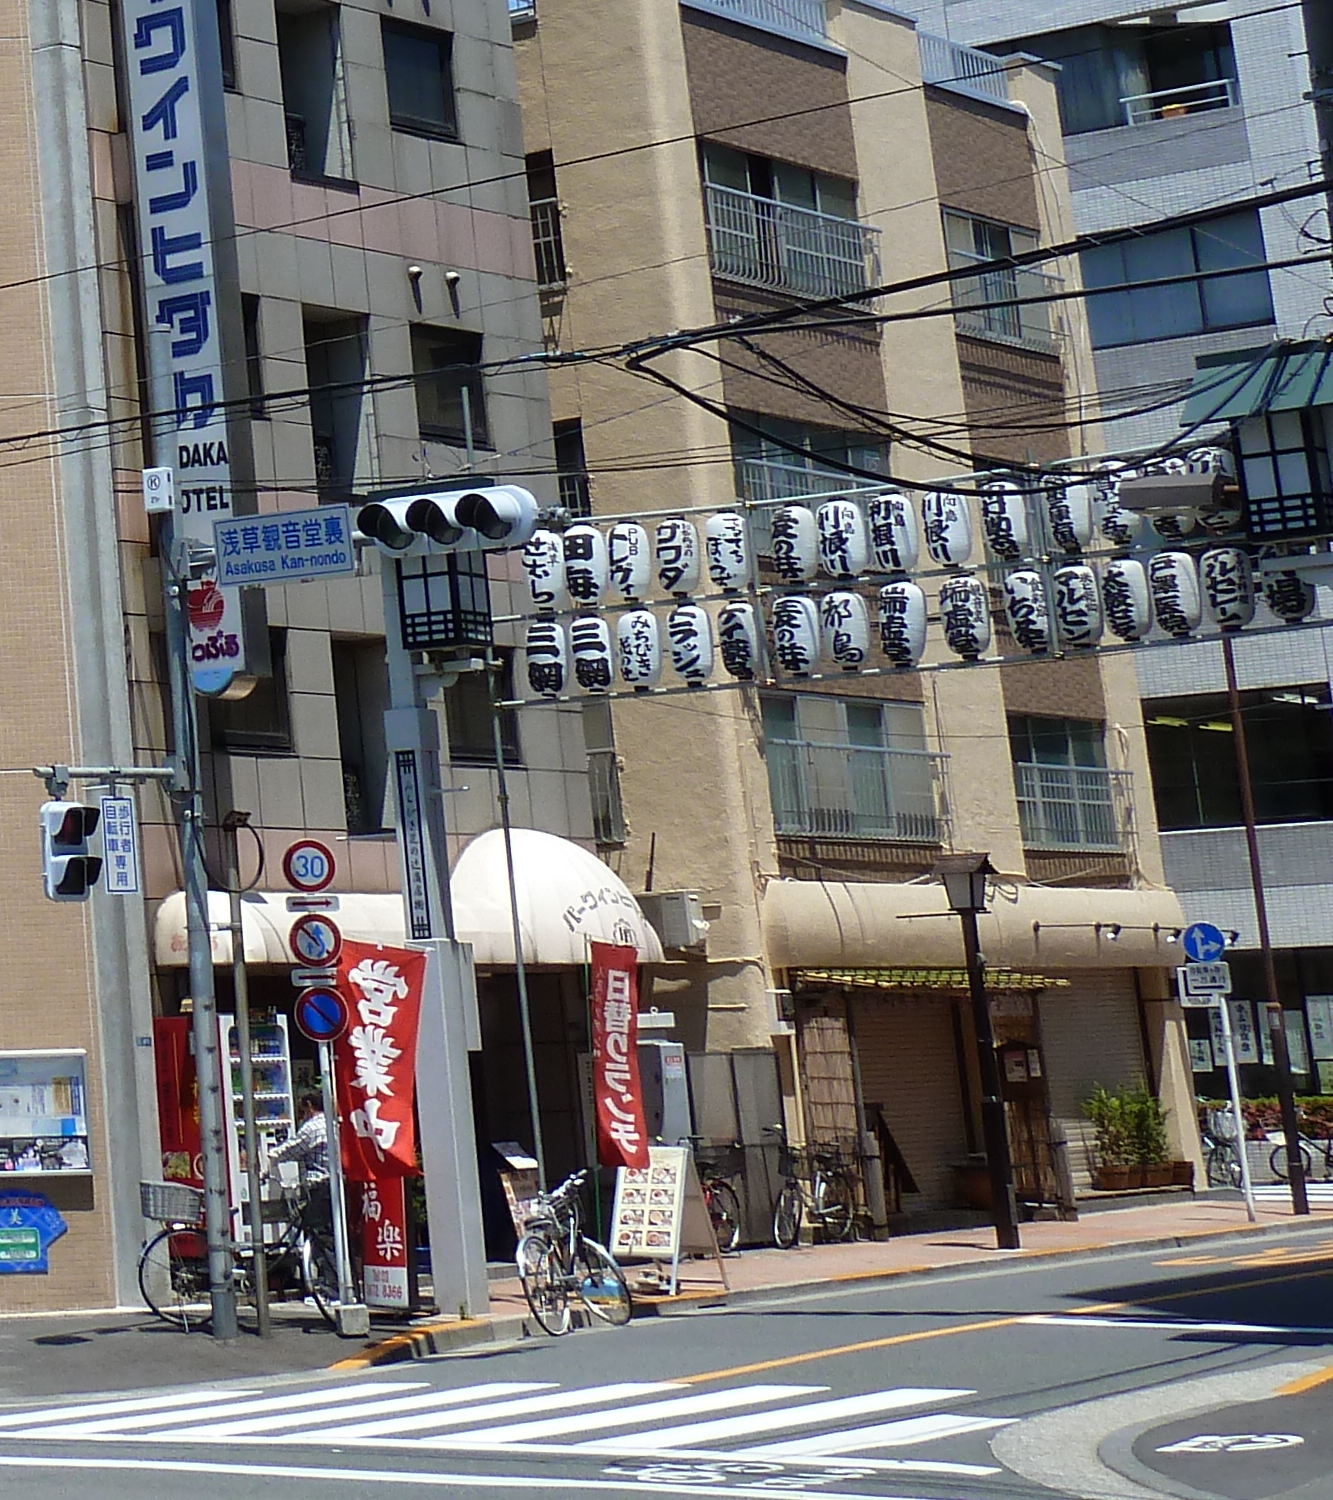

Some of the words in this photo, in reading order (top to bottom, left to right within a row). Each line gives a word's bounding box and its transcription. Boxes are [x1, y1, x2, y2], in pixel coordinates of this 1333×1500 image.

[220, 516, 345, 557] 浅草観音堂裏
[627, 527, 639, 556] PUB
[225, 559, 277, 577] Asakusa
[280, 551, 347, 571] Kan-nondo
[104, 804, 119, 853] 自転車
[118, 804, 132, 853] 歩行者
[114, 855, 129, 887] 専用
[294, 854, 325, 879] 30
[348, 958, 409, 1163] 営業中
